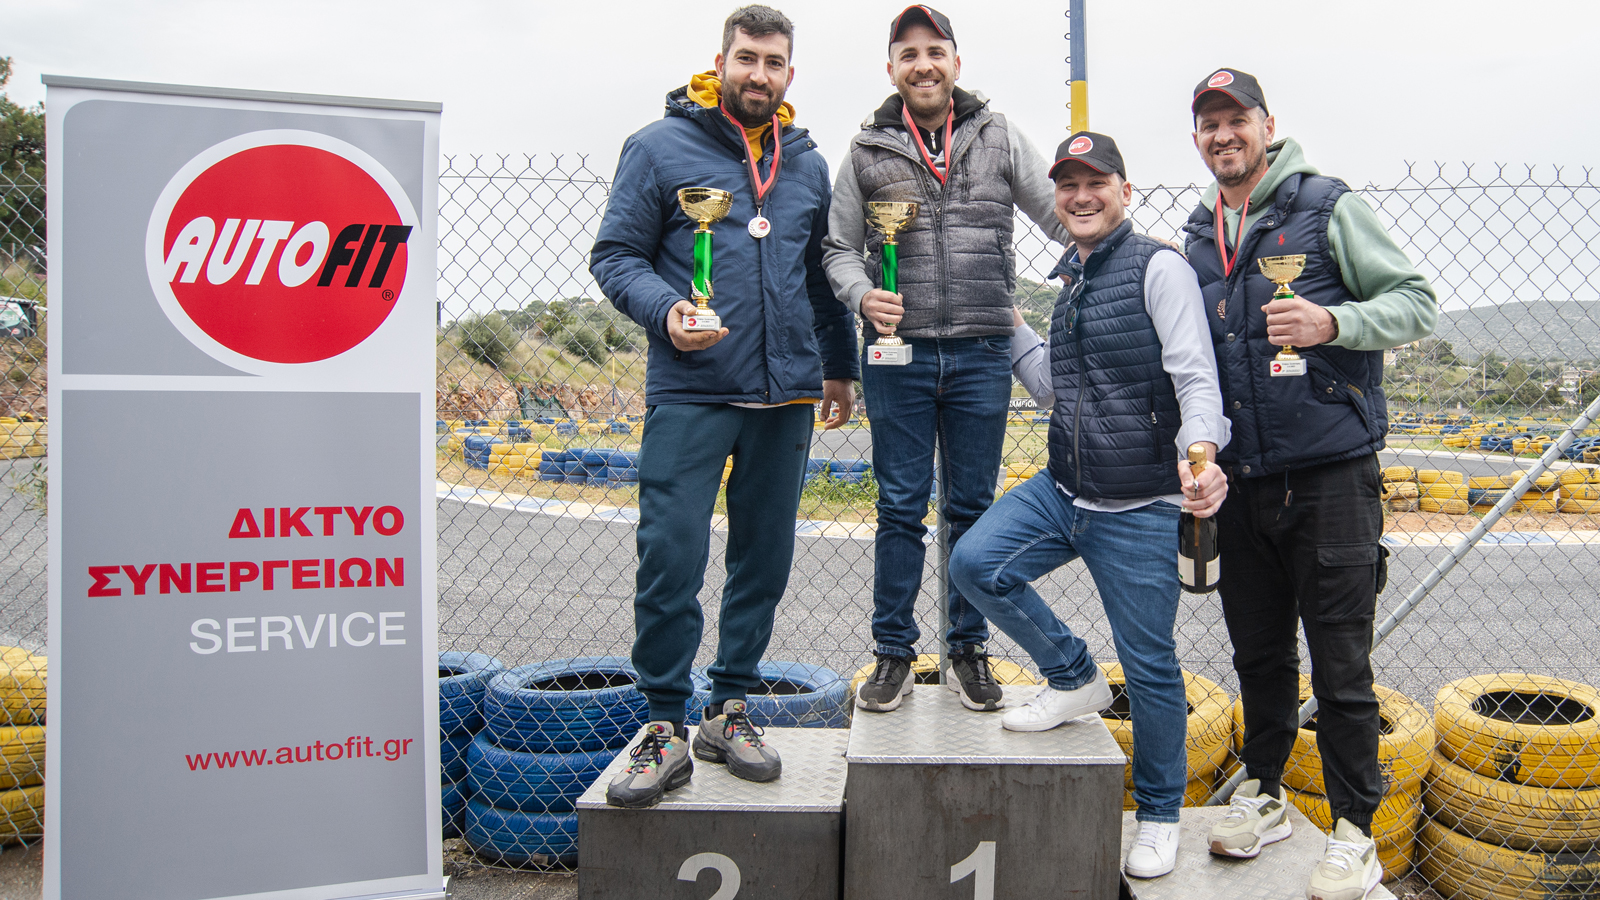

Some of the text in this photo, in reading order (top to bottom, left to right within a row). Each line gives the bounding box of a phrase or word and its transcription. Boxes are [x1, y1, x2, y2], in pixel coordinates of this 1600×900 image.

[164, 216, 414, 289] AUTOFIT
[229, 505, 404, 538] ΔΙΚΤΥΟ
[88, 557, 404, 597] ΣΥΝΕΡΓΕΙΩΝ
[189, 611, 407, 655] SERVICE
[185, 735, 413, 771] www.autofit.gr
[677, 852, 742, 900] 2
[950, 841, 996, 900] 1
